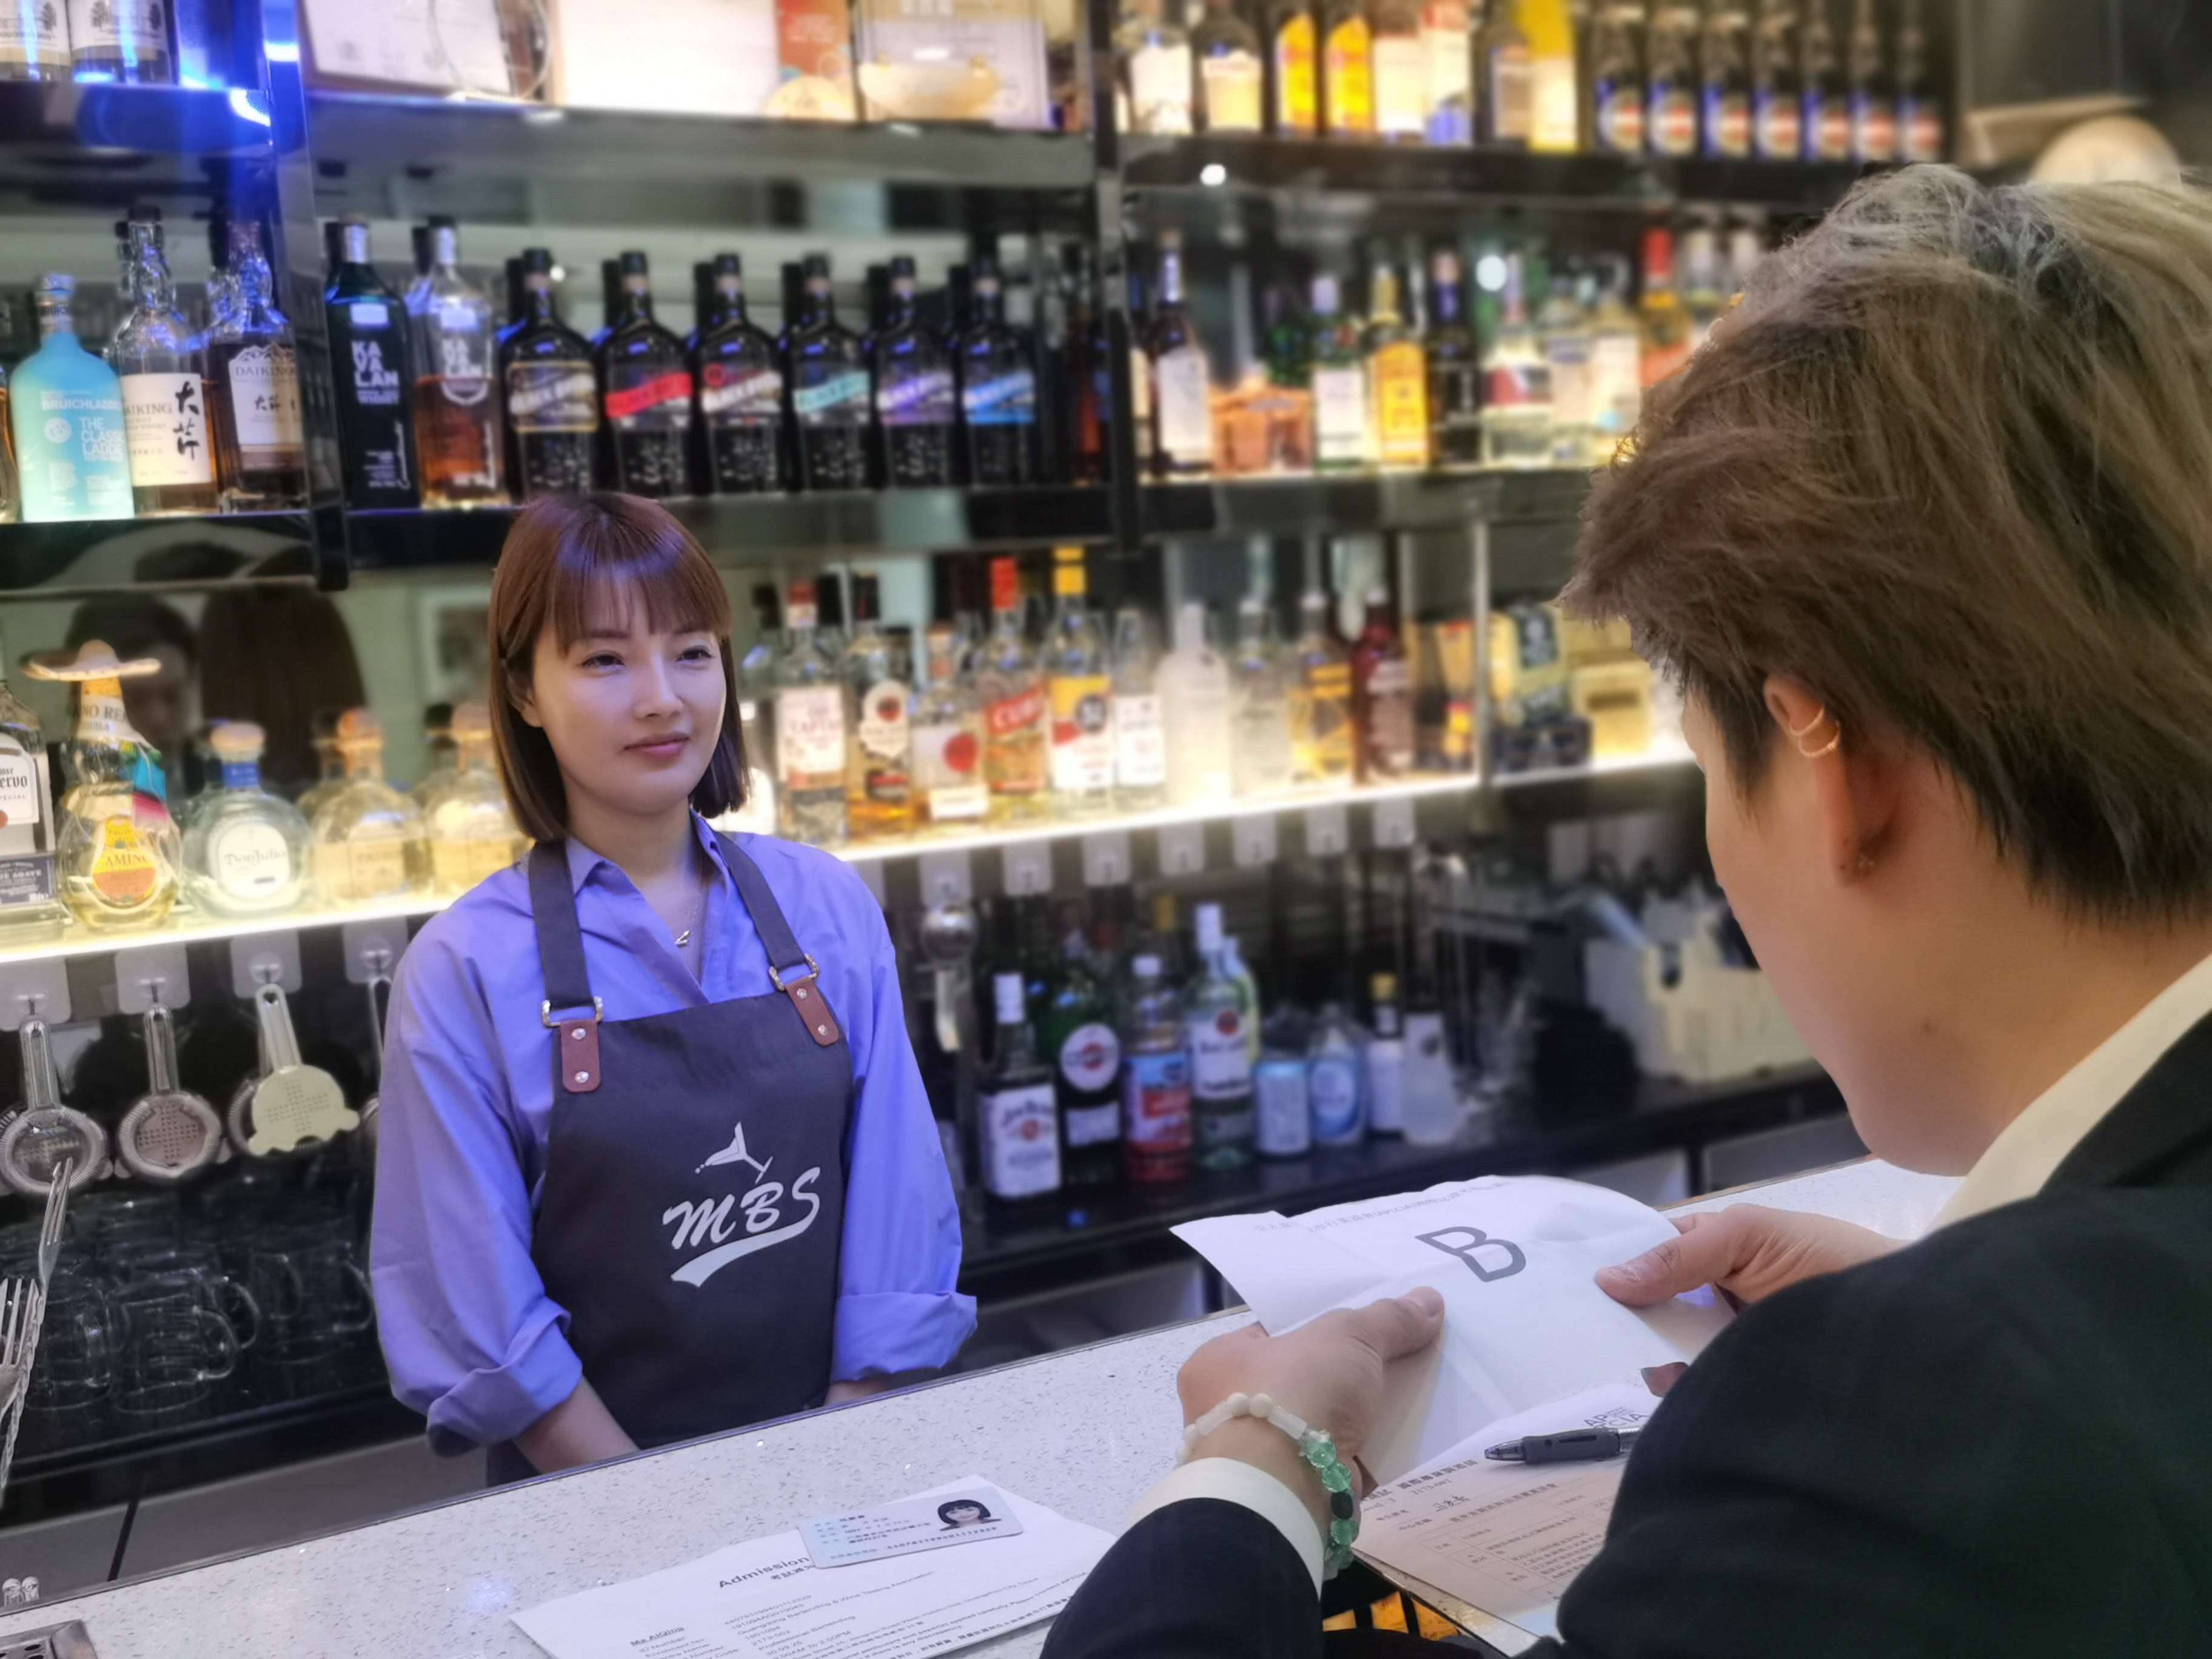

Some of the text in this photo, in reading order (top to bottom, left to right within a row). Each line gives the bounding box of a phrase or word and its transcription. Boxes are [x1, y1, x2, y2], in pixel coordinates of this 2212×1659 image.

[355, 370, 398, 387] LAN
[79, 417, 104, 430] THE
[662, 1167, 821, 1252] MBS
[1414, 1225, 1527, 1283] B
[719, 1556, 809, 1589] Admission
